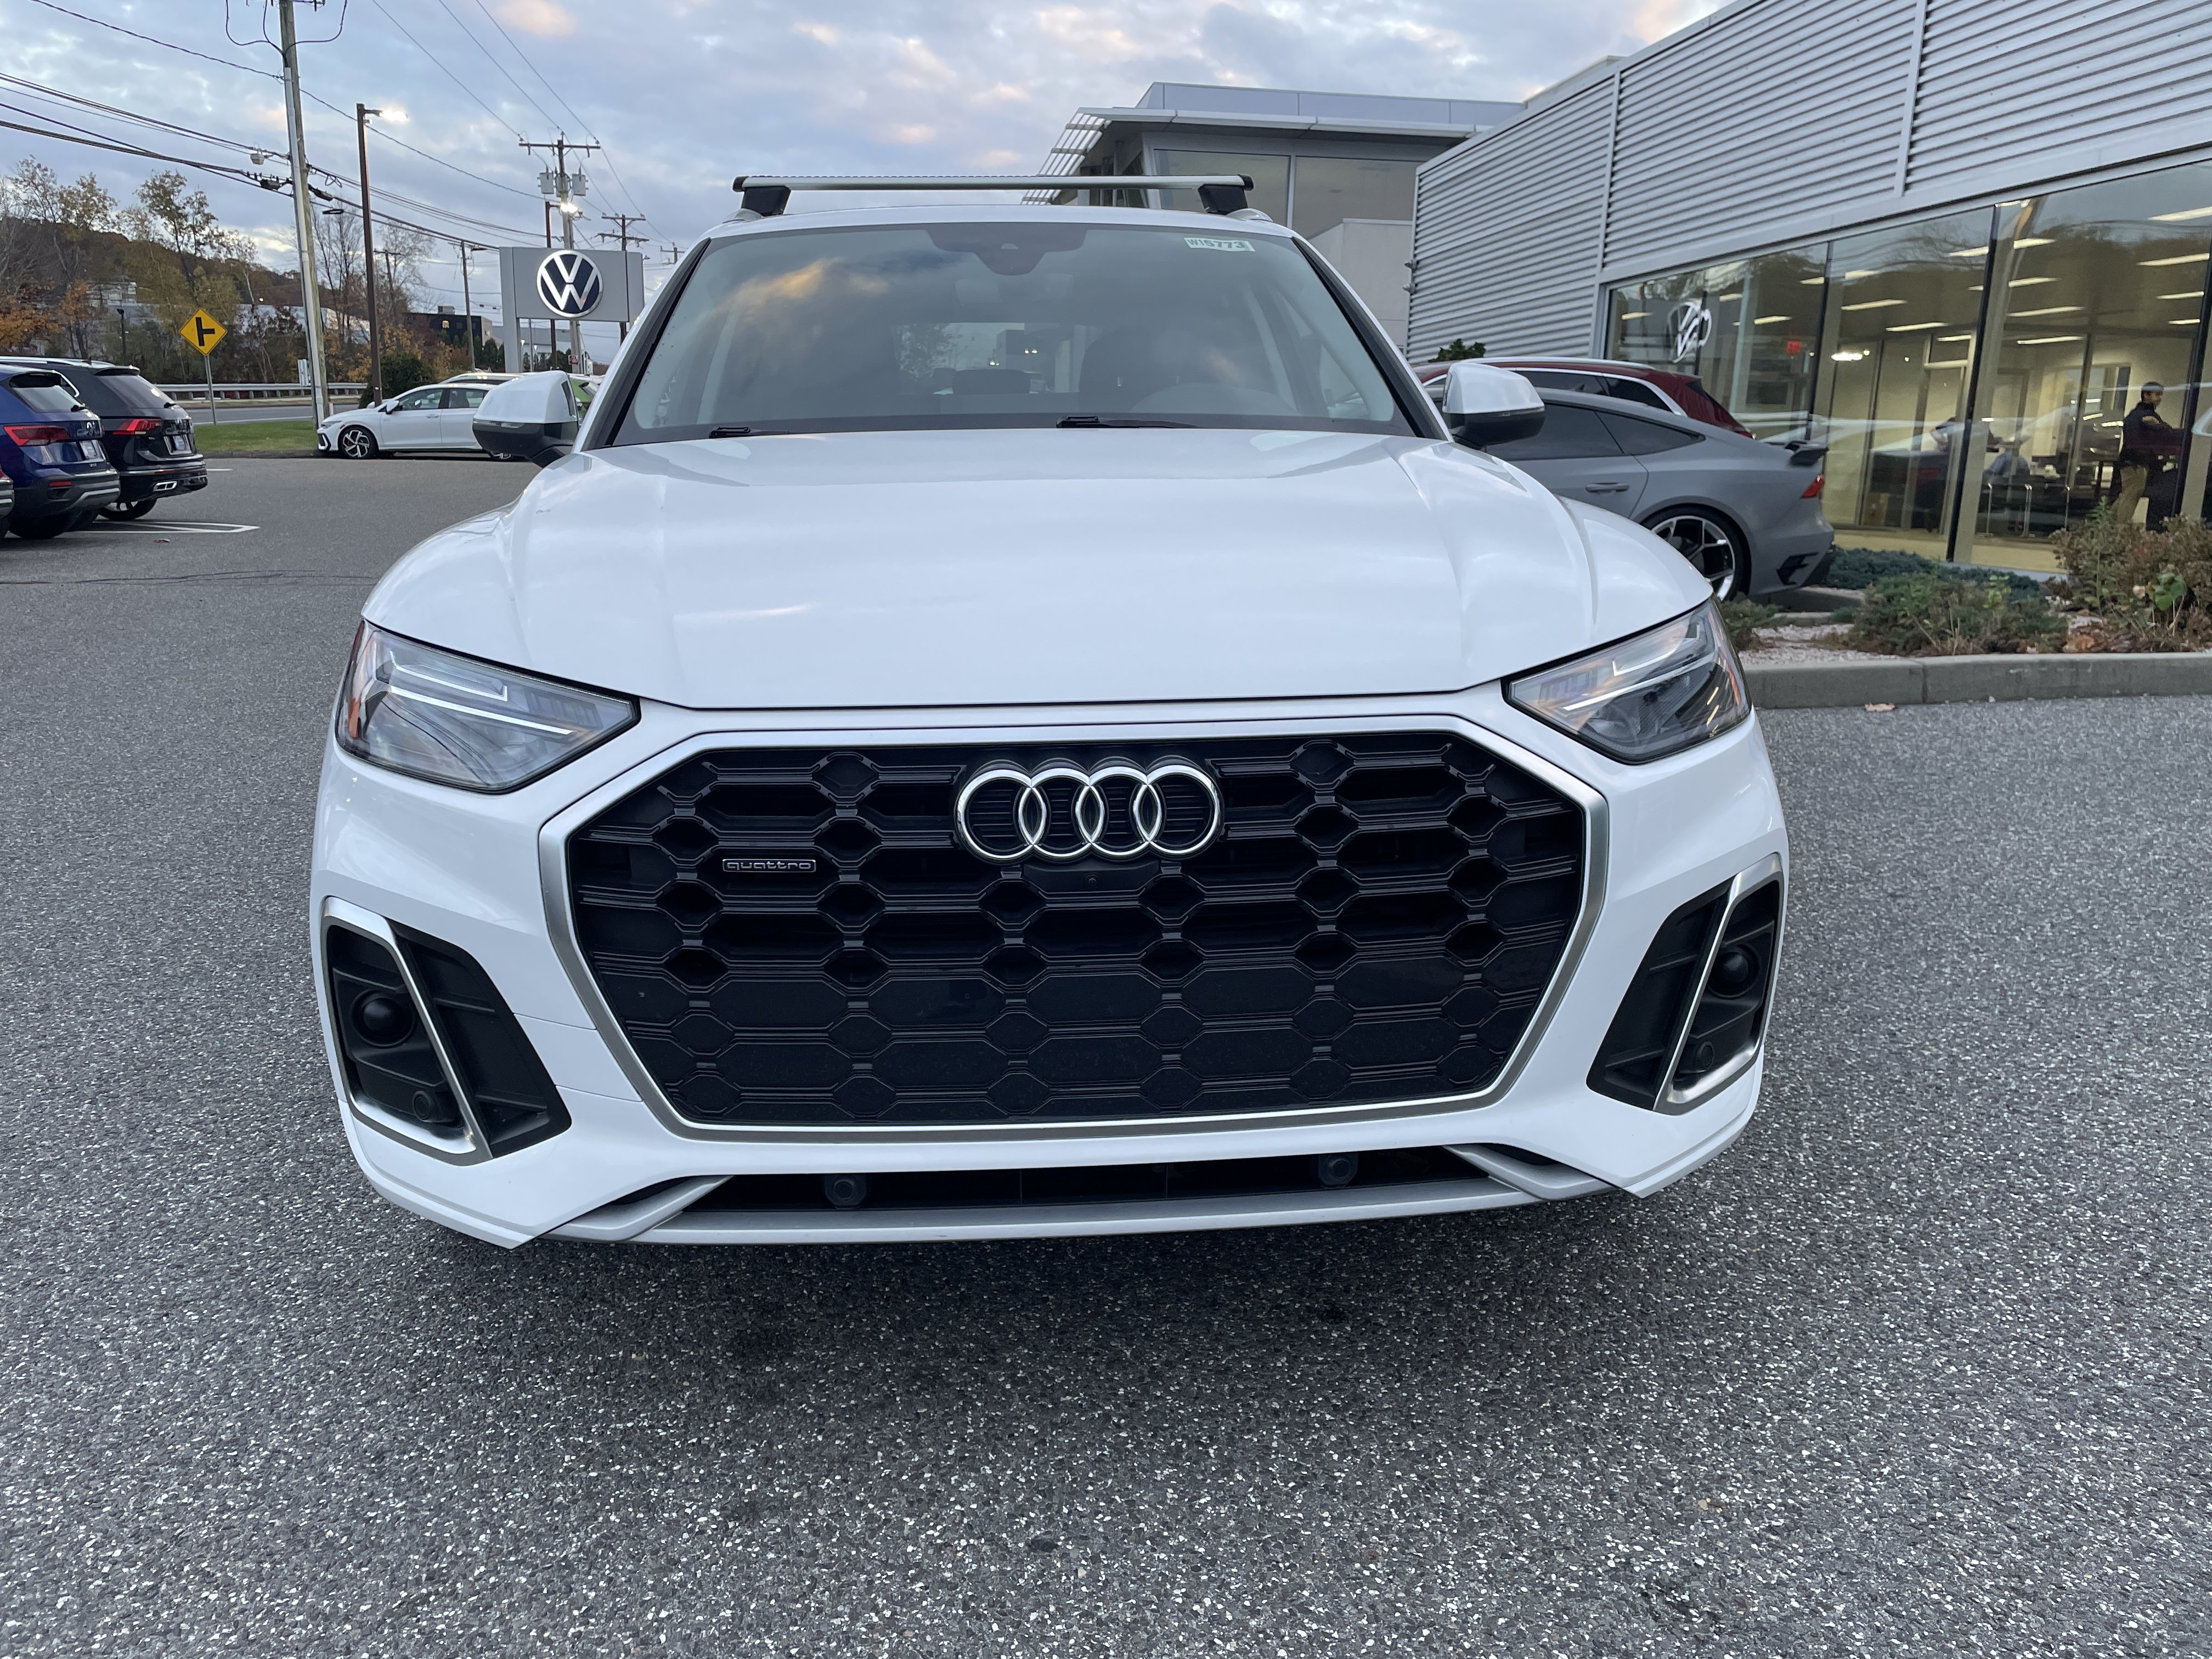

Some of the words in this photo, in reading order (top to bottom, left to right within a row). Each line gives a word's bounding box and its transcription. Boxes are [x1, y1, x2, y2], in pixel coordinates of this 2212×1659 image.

[1187, 239, 1245, 249] W15773
[538, 251, 602, 317] VW
[726, 861, 811, 871] quattro
